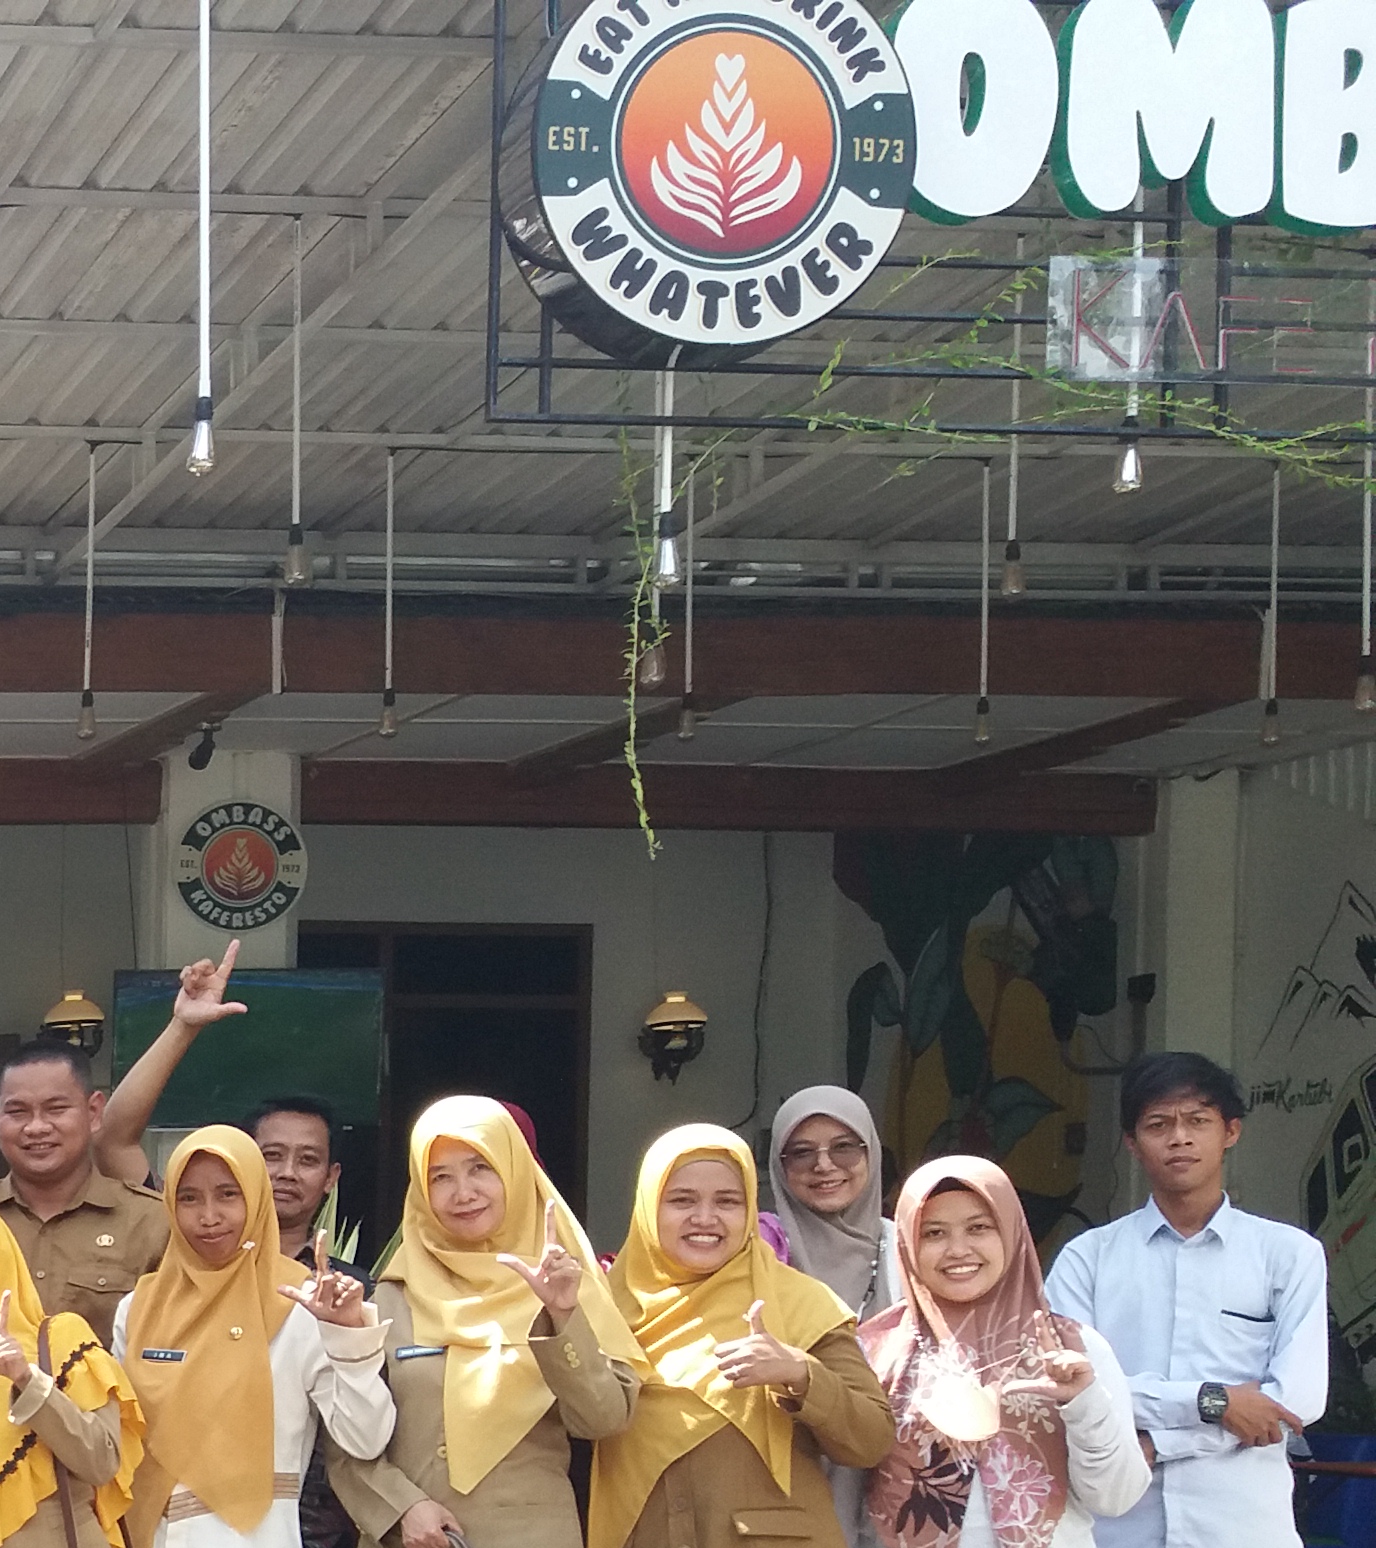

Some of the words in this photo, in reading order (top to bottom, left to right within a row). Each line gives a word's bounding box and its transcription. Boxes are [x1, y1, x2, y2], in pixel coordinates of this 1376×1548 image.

[770, 0, 886, 84] RINK
[547, 126, 599, 152] EST.
[852, 137, 904, 163] 1973
[571, 206, 874, 330] WHATEVER
[196, 805, 292, 841] OMBASS
[190, 889, 287, 928] KAFERESTO
